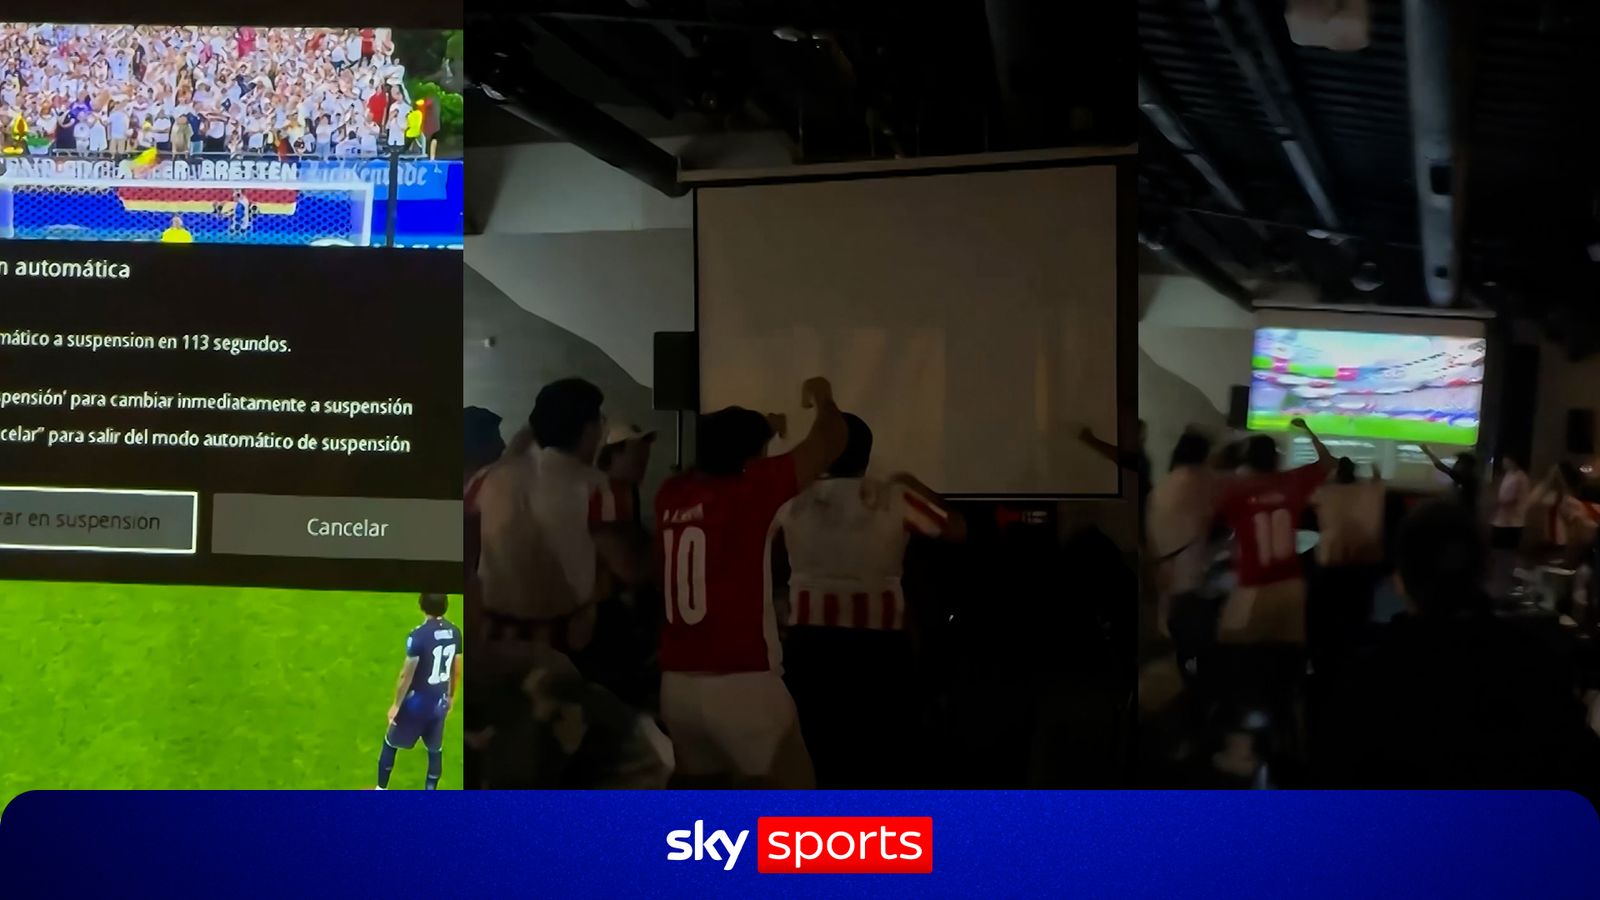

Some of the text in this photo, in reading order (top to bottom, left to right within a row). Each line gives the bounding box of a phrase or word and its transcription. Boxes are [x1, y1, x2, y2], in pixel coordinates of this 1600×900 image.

[15, 259, 131, 279] automática
[53, 333, 63, 347] a
[67, 331, 155, 352] suspension
[158, 336, 178, 350] en
[182, 334, 210, 351] 113
[213, 334, 292, 356] segundos.
[0, 388, 413, 419] pensión' para cambiar inmediatamente a suspensión
[48, 429, 85, 447] para
[88, 426, 121, 445] salir
[124, 428, 149, 446] del
[152, 429, 200, 447] modo
[203, 431, 293, 450] automático
[297, 433, 318, 451] de
[322, 434, 411, 456] suspensión
[28, 512, 50, 527] en
[306, 518, 389, 538] Cancelar
[663, 526, 707, 625] 10
[428, 644, 456, 685] 13
